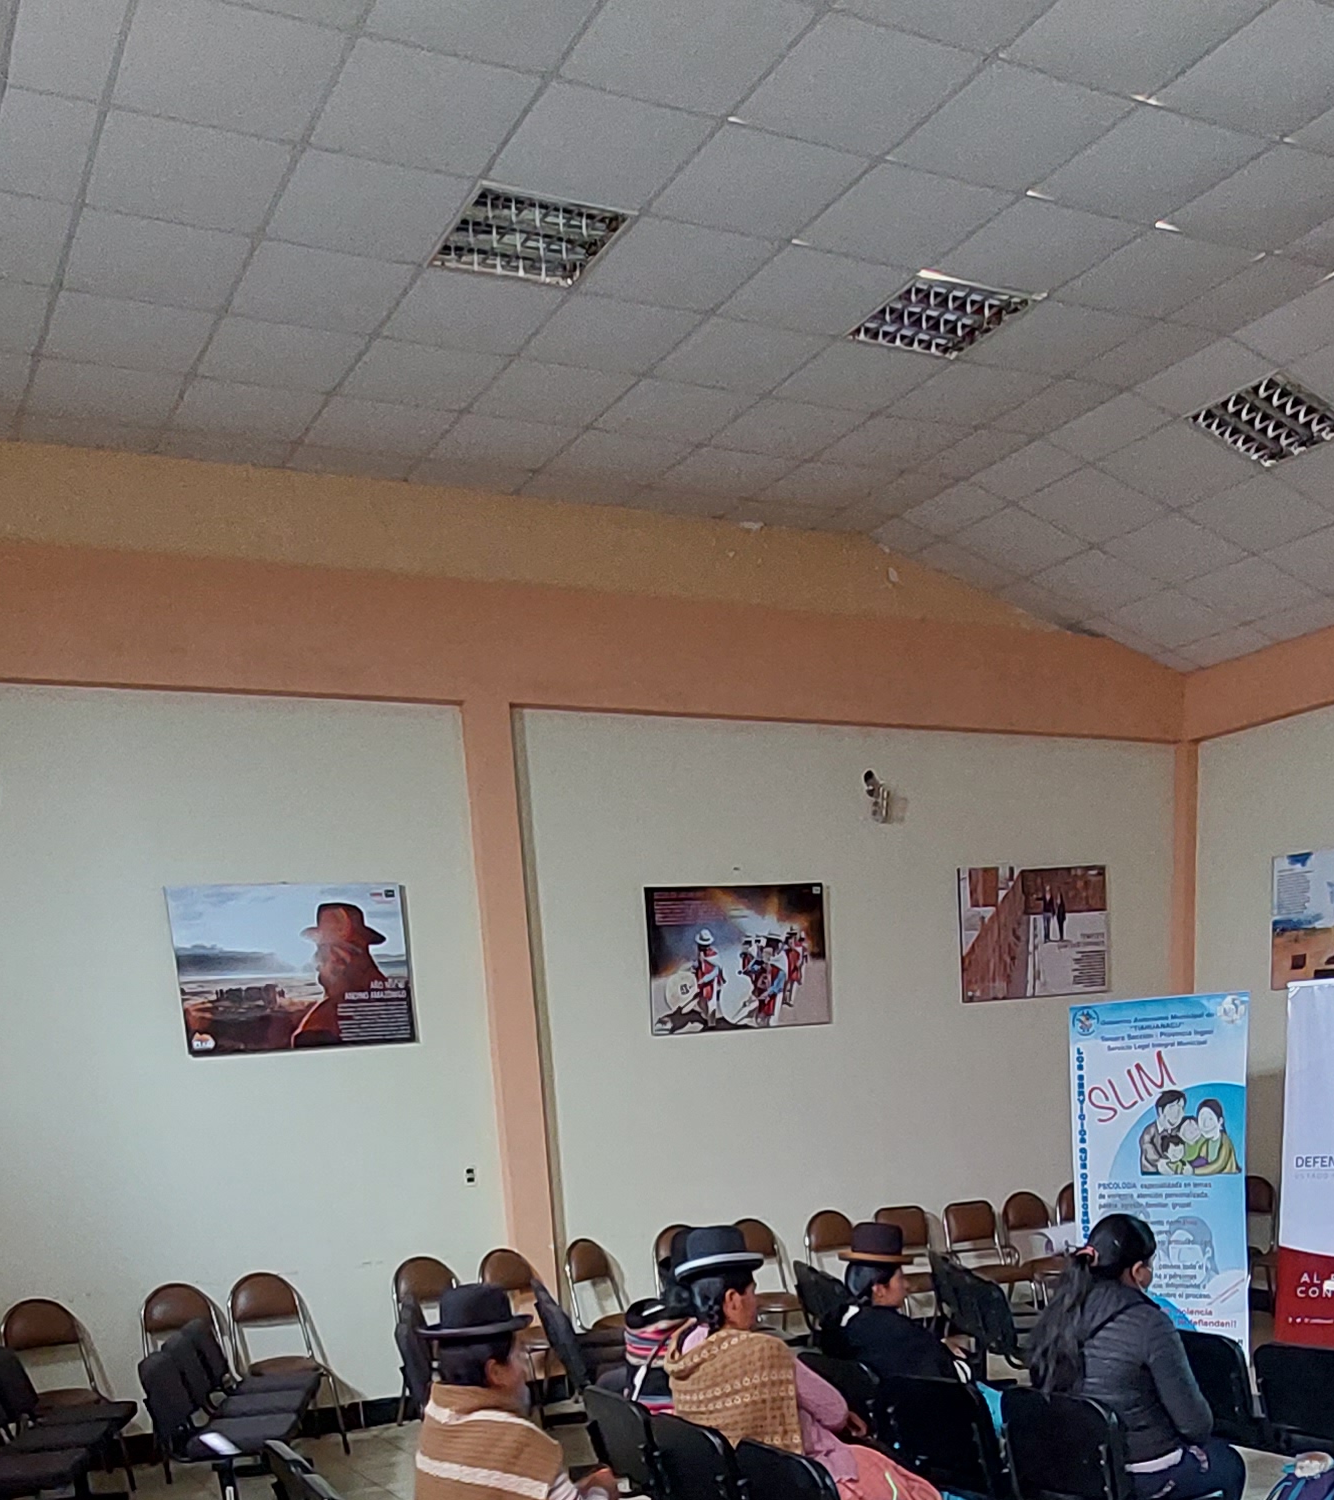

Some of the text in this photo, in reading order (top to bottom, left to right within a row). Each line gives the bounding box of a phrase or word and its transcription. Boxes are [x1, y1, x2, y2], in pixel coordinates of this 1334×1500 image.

[1087, 1049, 1178, 1123] SLIM
[1300, 1272, 1321, 1283] AL
[1296, 1286, 1333, 1298] CON
